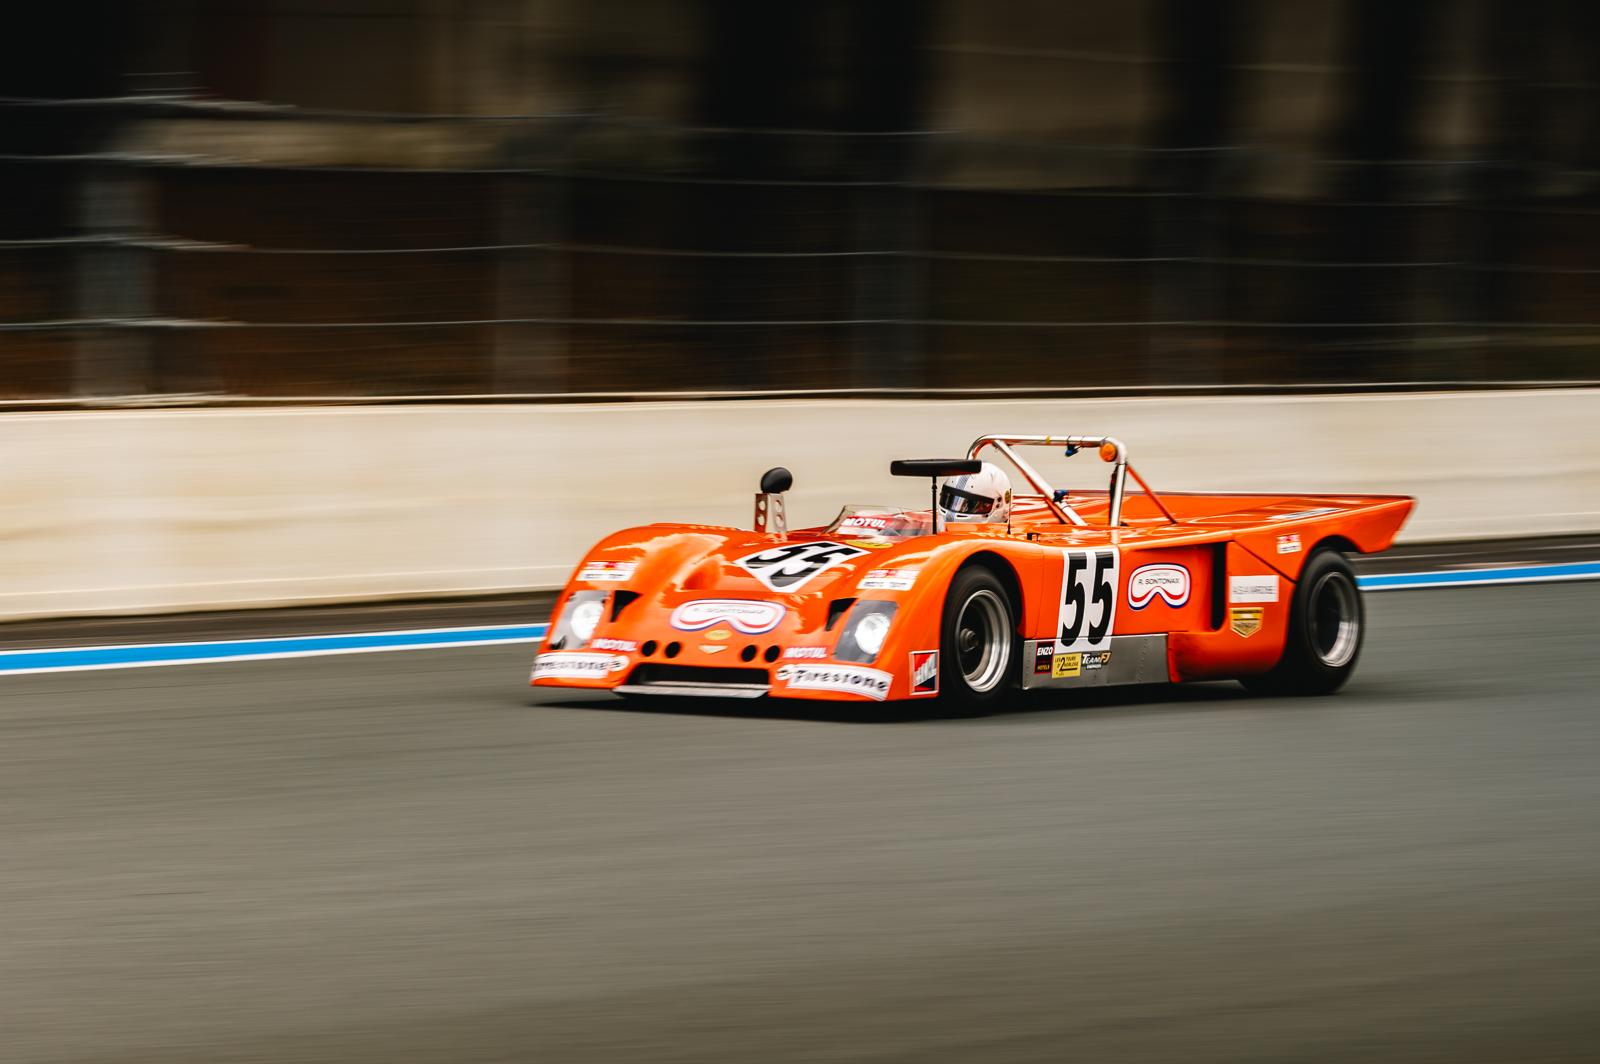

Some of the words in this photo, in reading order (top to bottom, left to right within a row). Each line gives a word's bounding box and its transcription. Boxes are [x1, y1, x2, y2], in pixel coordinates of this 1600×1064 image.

[841, 517, 886, 528] MOTUL
[745, 542, 861, 587] 55
[1061, 551, 1115, 647] 55
[1037, 646, 1053, 656] ENZO
[793, 668, 888, 692] Firestone
